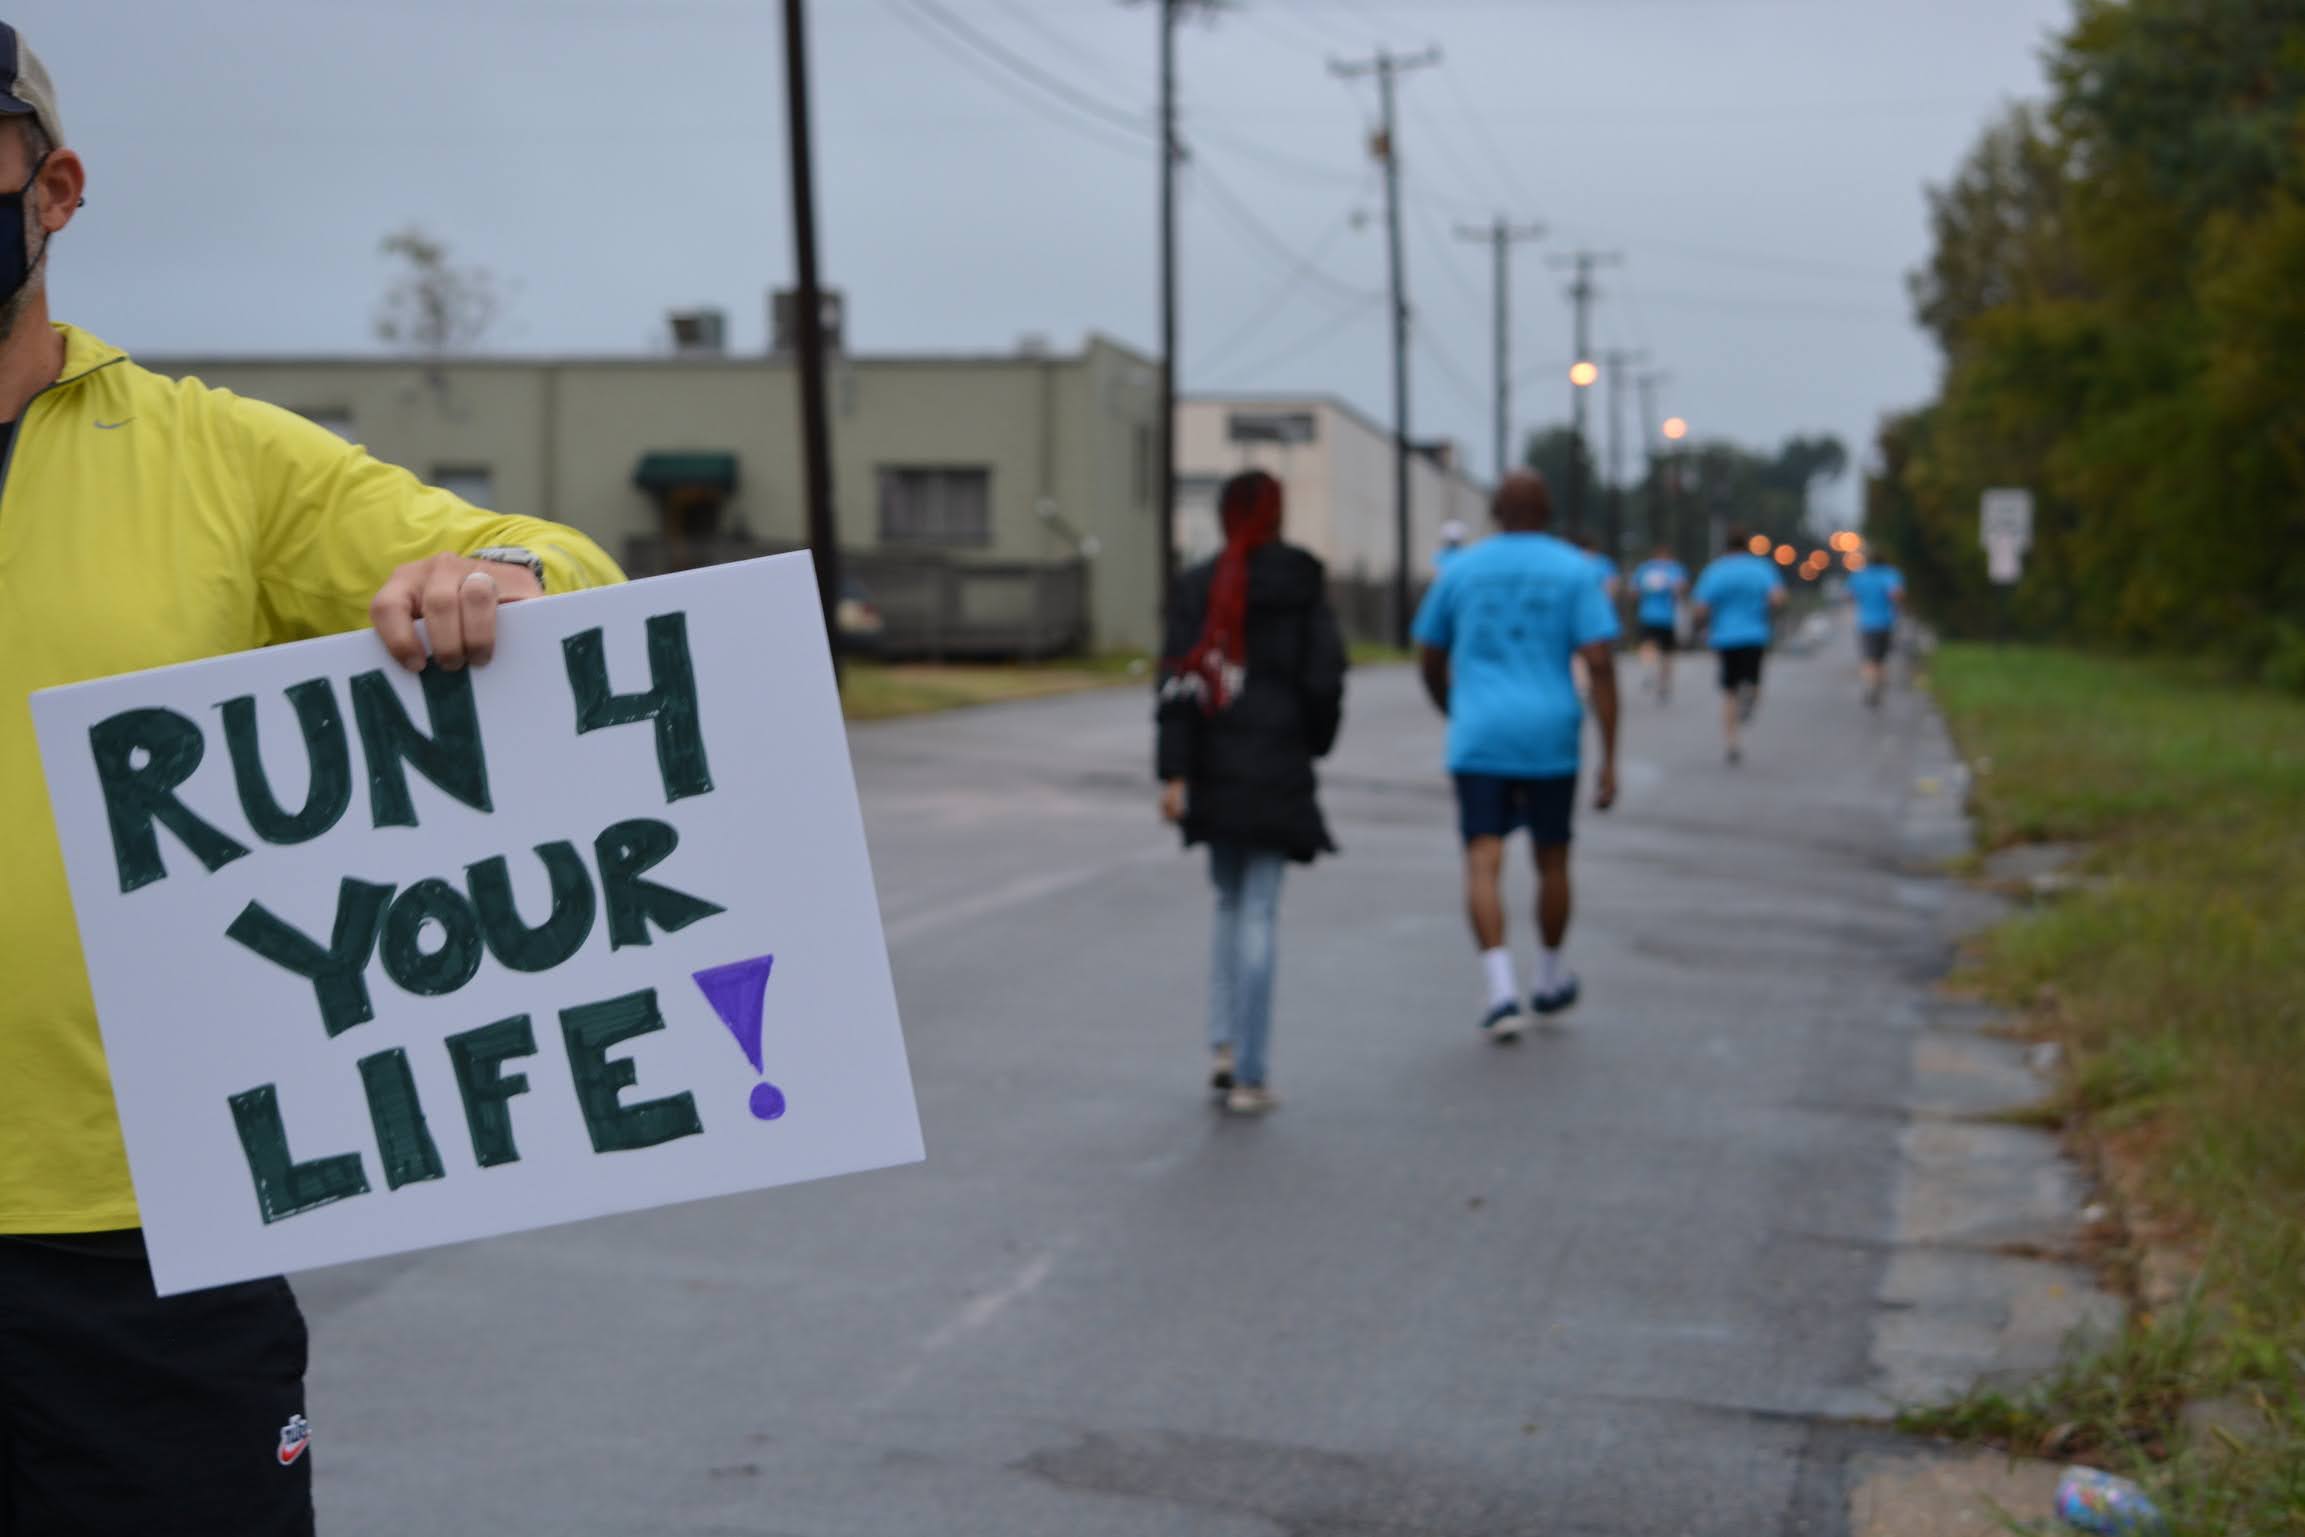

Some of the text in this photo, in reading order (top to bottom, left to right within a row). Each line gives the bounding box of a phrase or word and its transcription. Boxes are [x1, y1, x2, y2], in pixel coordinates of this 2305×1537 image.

[88, 611, 715, 894] RUN 4
[225, 818, 728, 1039] YOUR
[227, 953, 787, 1225] LIFE!
